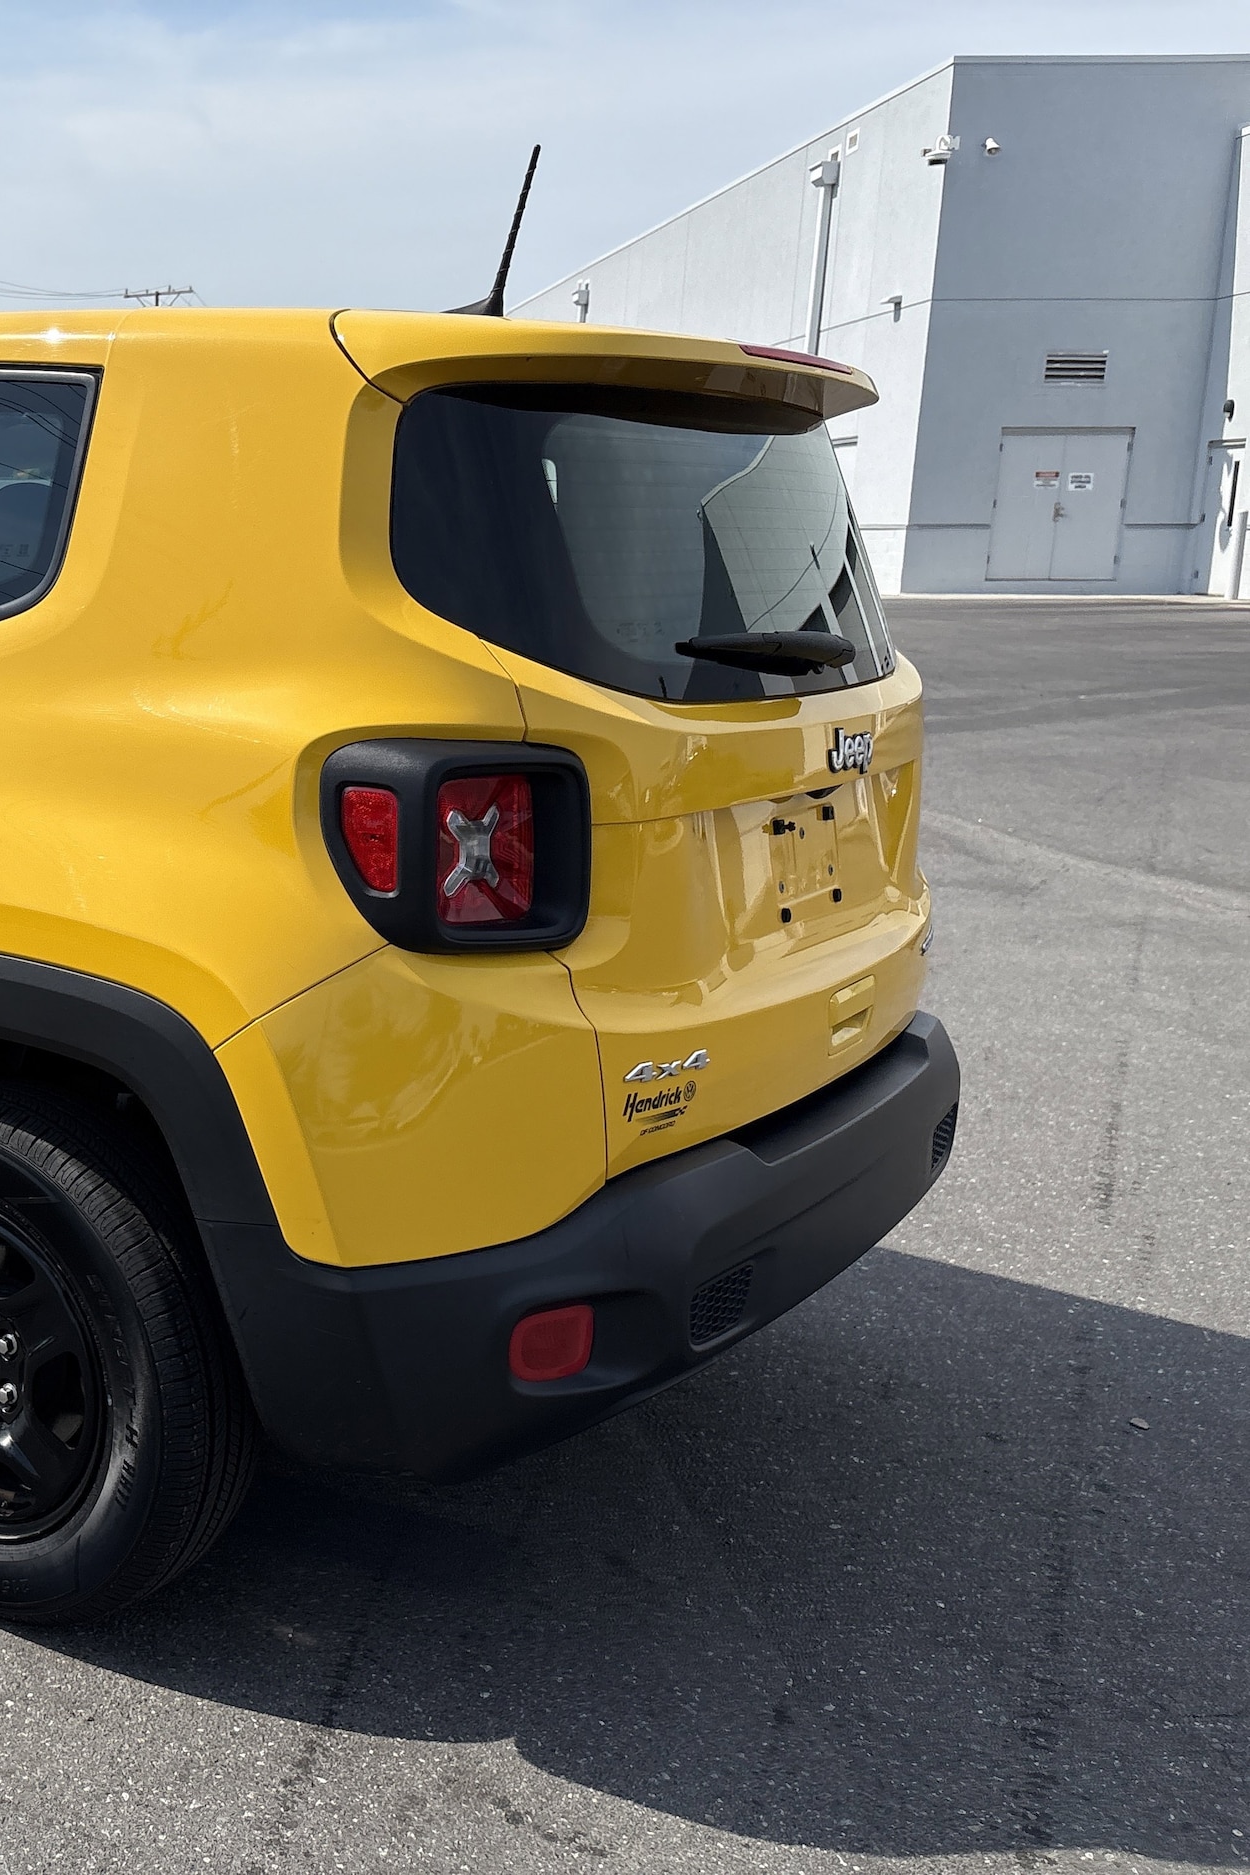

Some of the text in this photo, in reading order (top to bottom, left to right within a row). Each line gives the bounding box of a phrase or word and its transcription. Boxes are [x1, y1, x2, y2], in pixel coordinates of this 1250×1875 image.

[828, 727, 873, 774] Jeep
[623, 1048, 710, 1082] 4x4
[622, 1086, 682, 1122] Hendrick
